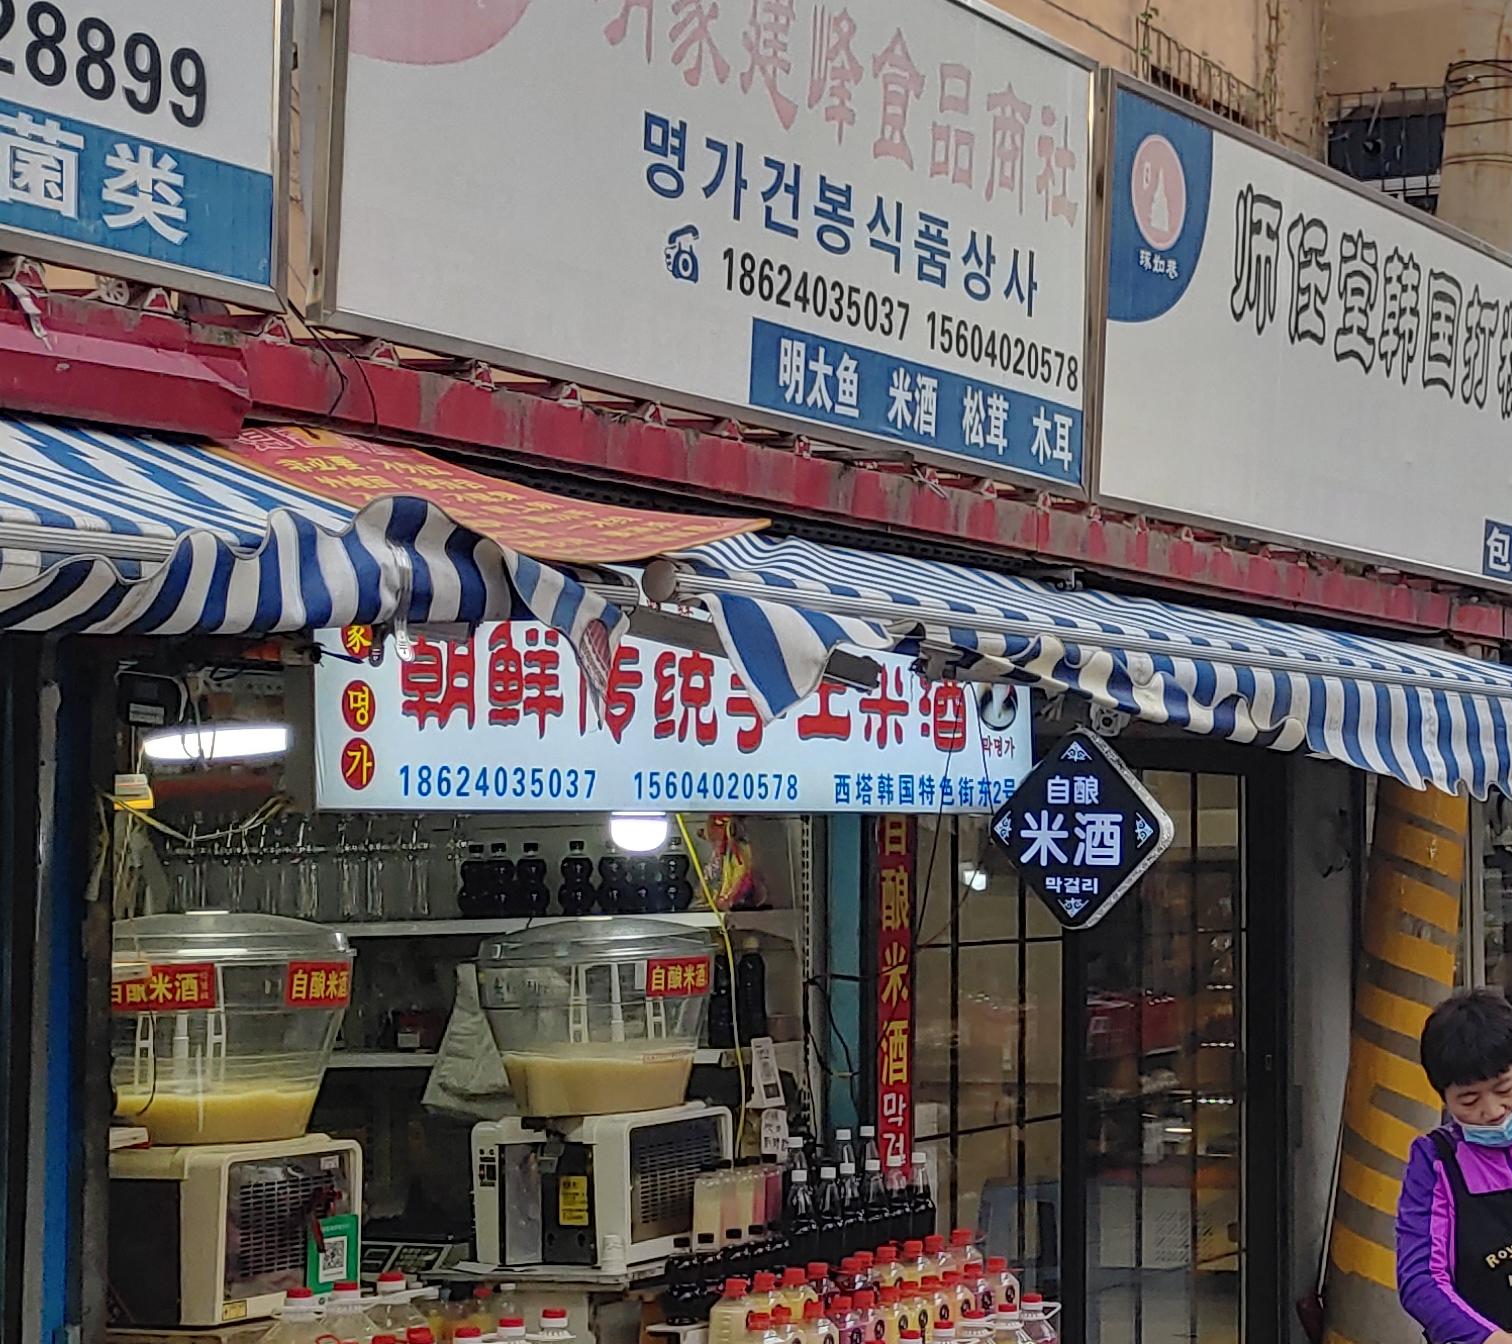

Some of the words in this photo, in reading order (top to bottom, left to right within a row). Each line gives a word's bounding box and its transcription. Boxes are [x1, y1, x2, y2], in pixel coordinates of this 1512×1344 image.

[643, 110, 1038, 318] 명가건봉식품상사
[722, 247, 910, 341] 18624035037
[926, 310, 1079, 392] 15604020578
[778, 336, 860, 419] 明太鱼
[888, 368, 938, 438] 米酒
[962, 385, 1008, 455] 松茸
[1031, 405, 1073, 471] 木耳
[981, 736, 1016, 758] 막명가
[399, 764, 597, 800] 18624035037
[634, 771, 798, 801] 15604020578
[1047, 775, 1099, 805] 自酿
[1020, 809, 1123, 867] 米酒
[1045, 876, 1099, 895] 막걸리
[651, 965, 707, 996] 自酿米酒
